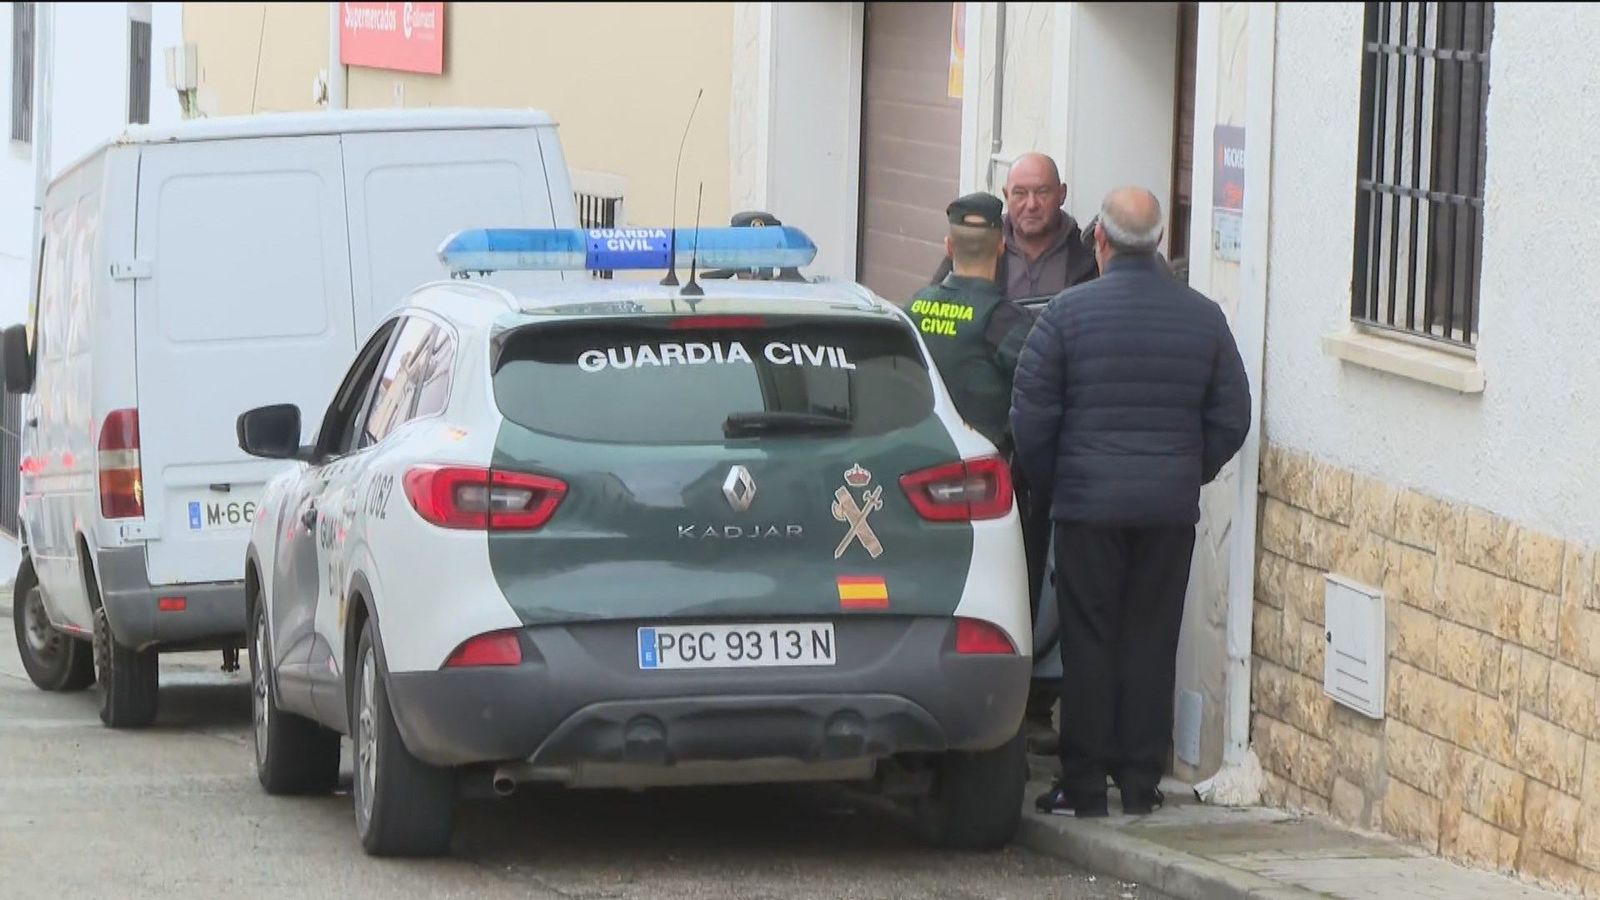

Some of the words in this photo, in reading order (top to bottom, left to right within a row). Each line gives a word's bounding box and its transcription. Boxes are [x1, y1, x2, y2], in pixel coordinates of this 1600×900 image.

[589, 228, 667, 240] GUARDIA
[607, 239, 653, 251] CIVIL
[911, 300, 974, 321] GUARDIA
[921, 318, 957, 335] CIVIL
[578, 341, 753, 373] GUARDIA
[764, 341, 857, 370] CIVIL
[677, 524, 803, 539] KADJAR
[657, 632, 716, 663] PGC
[725, 629, 803, 662] 9313
[811, 629, 832, 660] N
